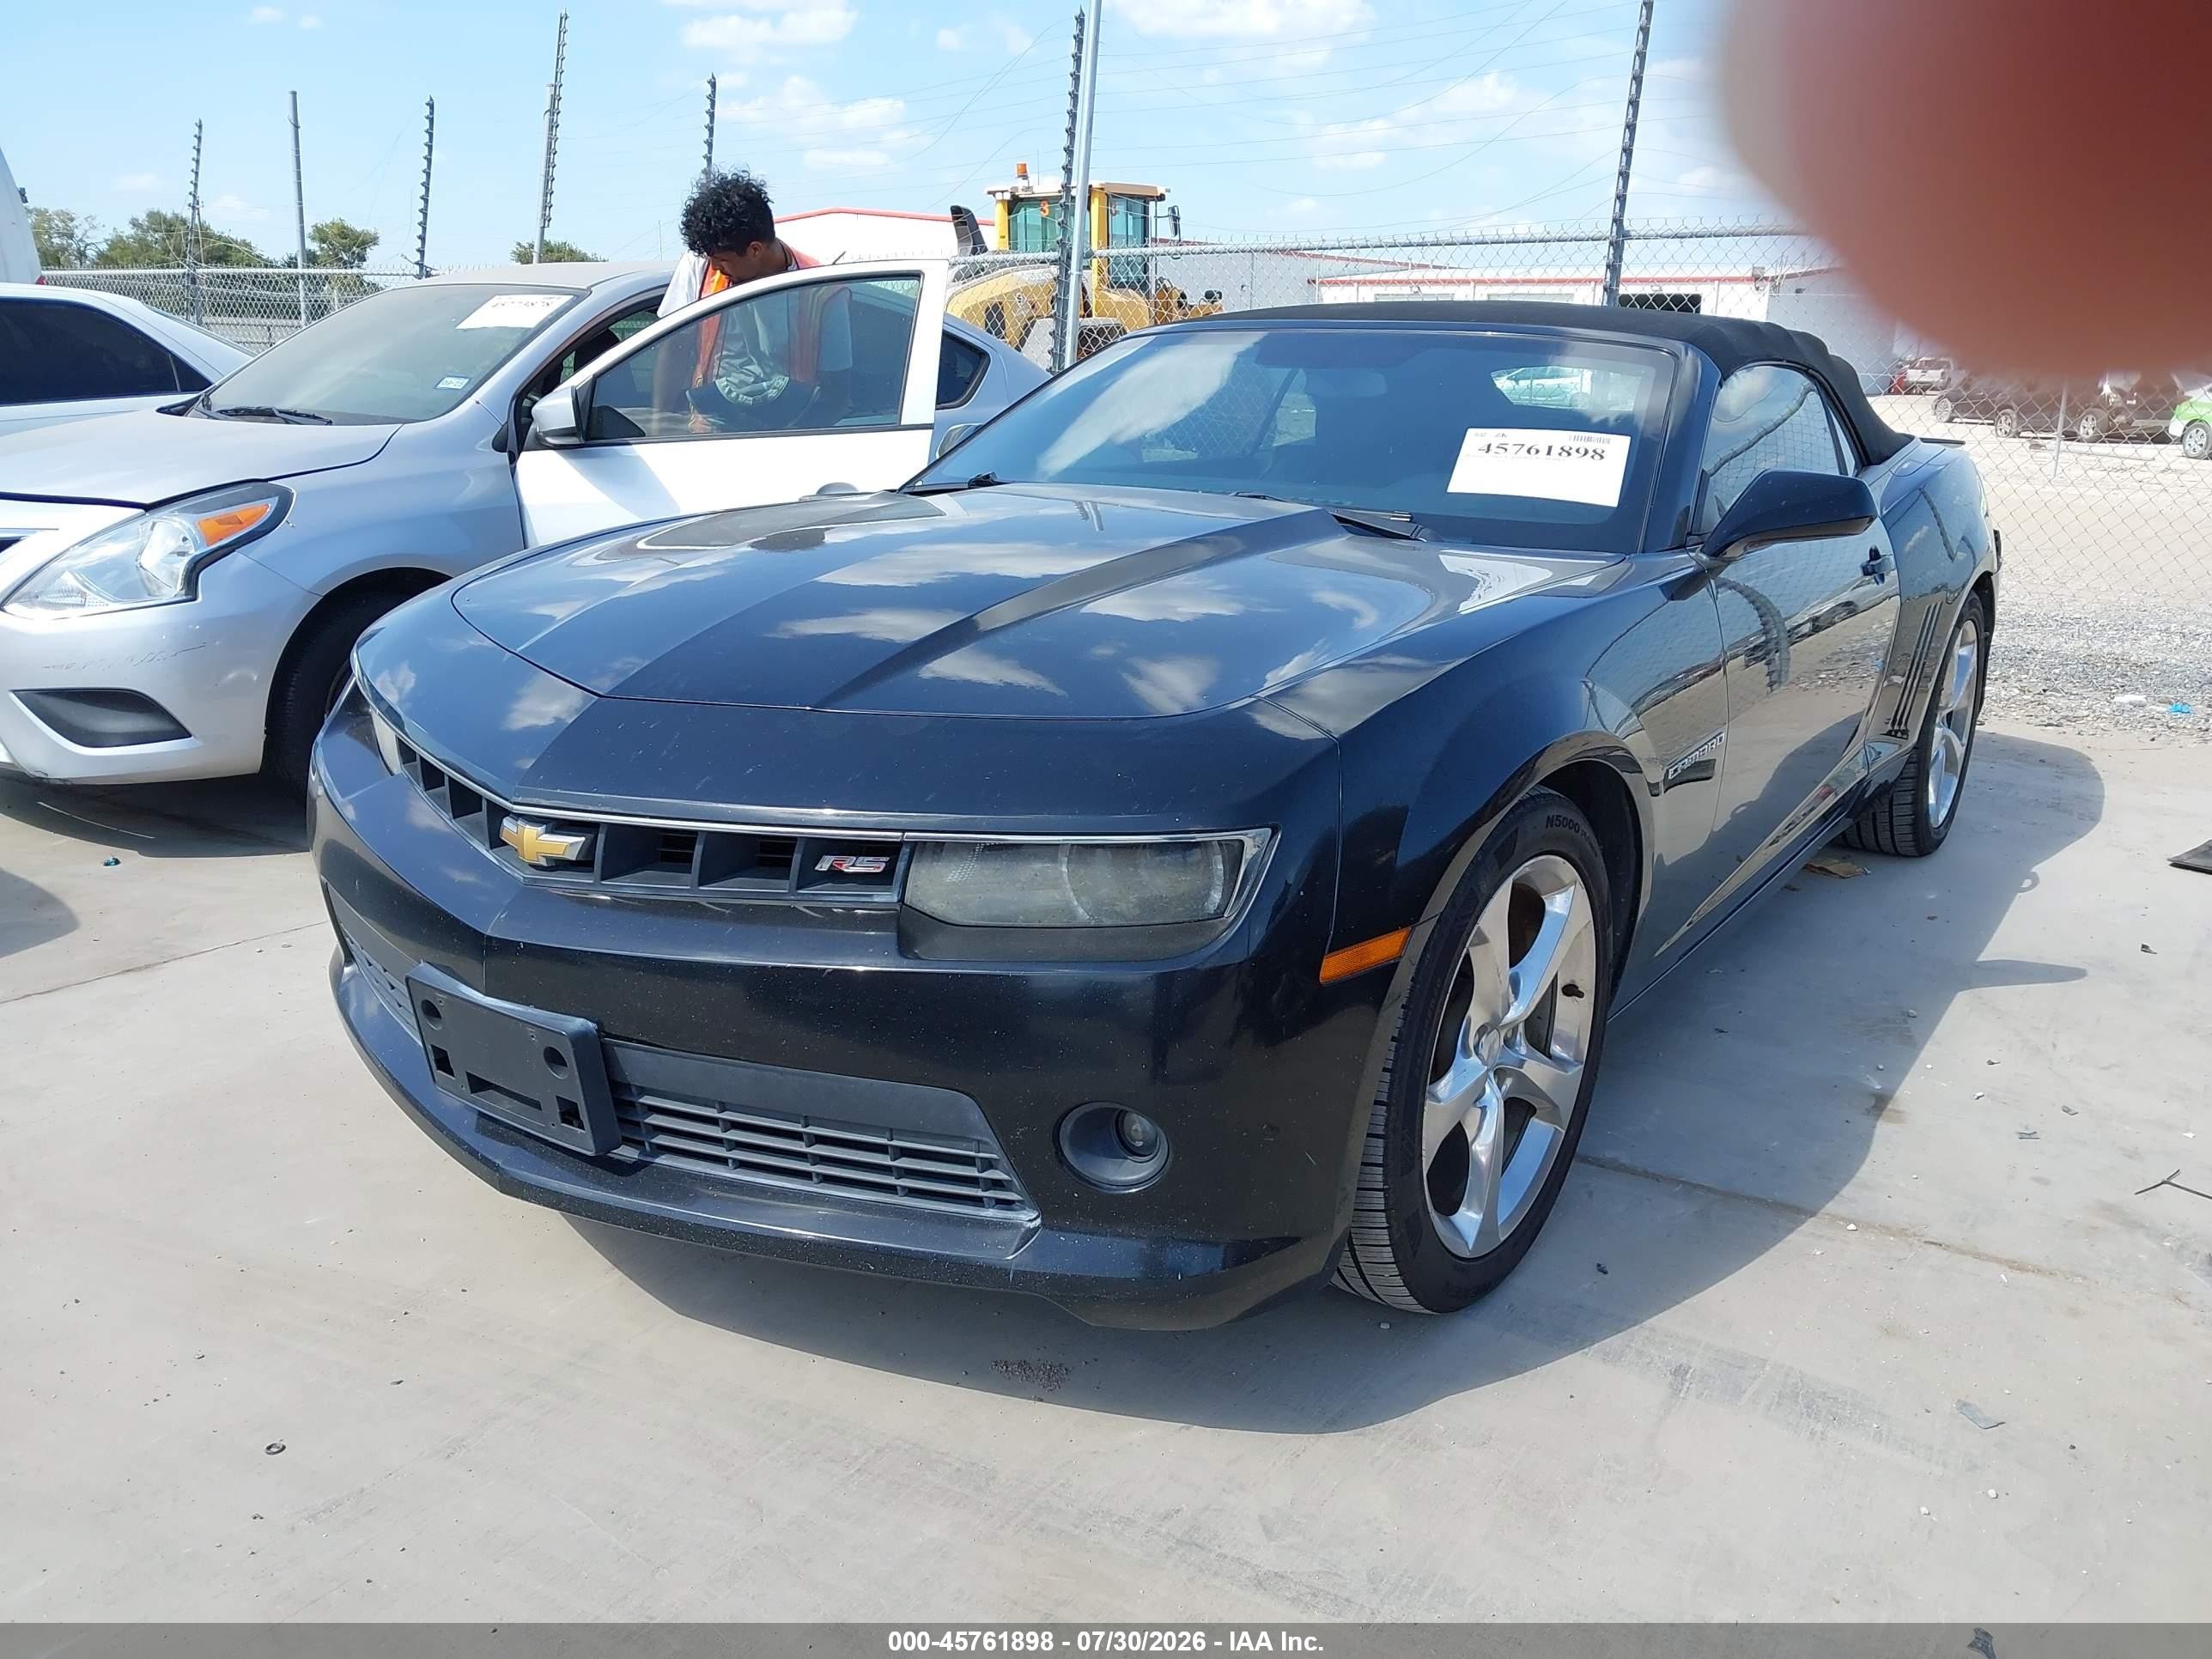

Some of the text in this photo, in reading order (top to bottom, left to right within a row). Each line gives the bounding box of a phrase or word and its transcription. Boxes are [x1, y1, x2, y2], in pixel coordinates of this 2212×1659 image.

[1478, 442, 1605, 461] 45761898
[1546, 814, 1580, 833] N5000
[814, 855, 890, 872] RS
